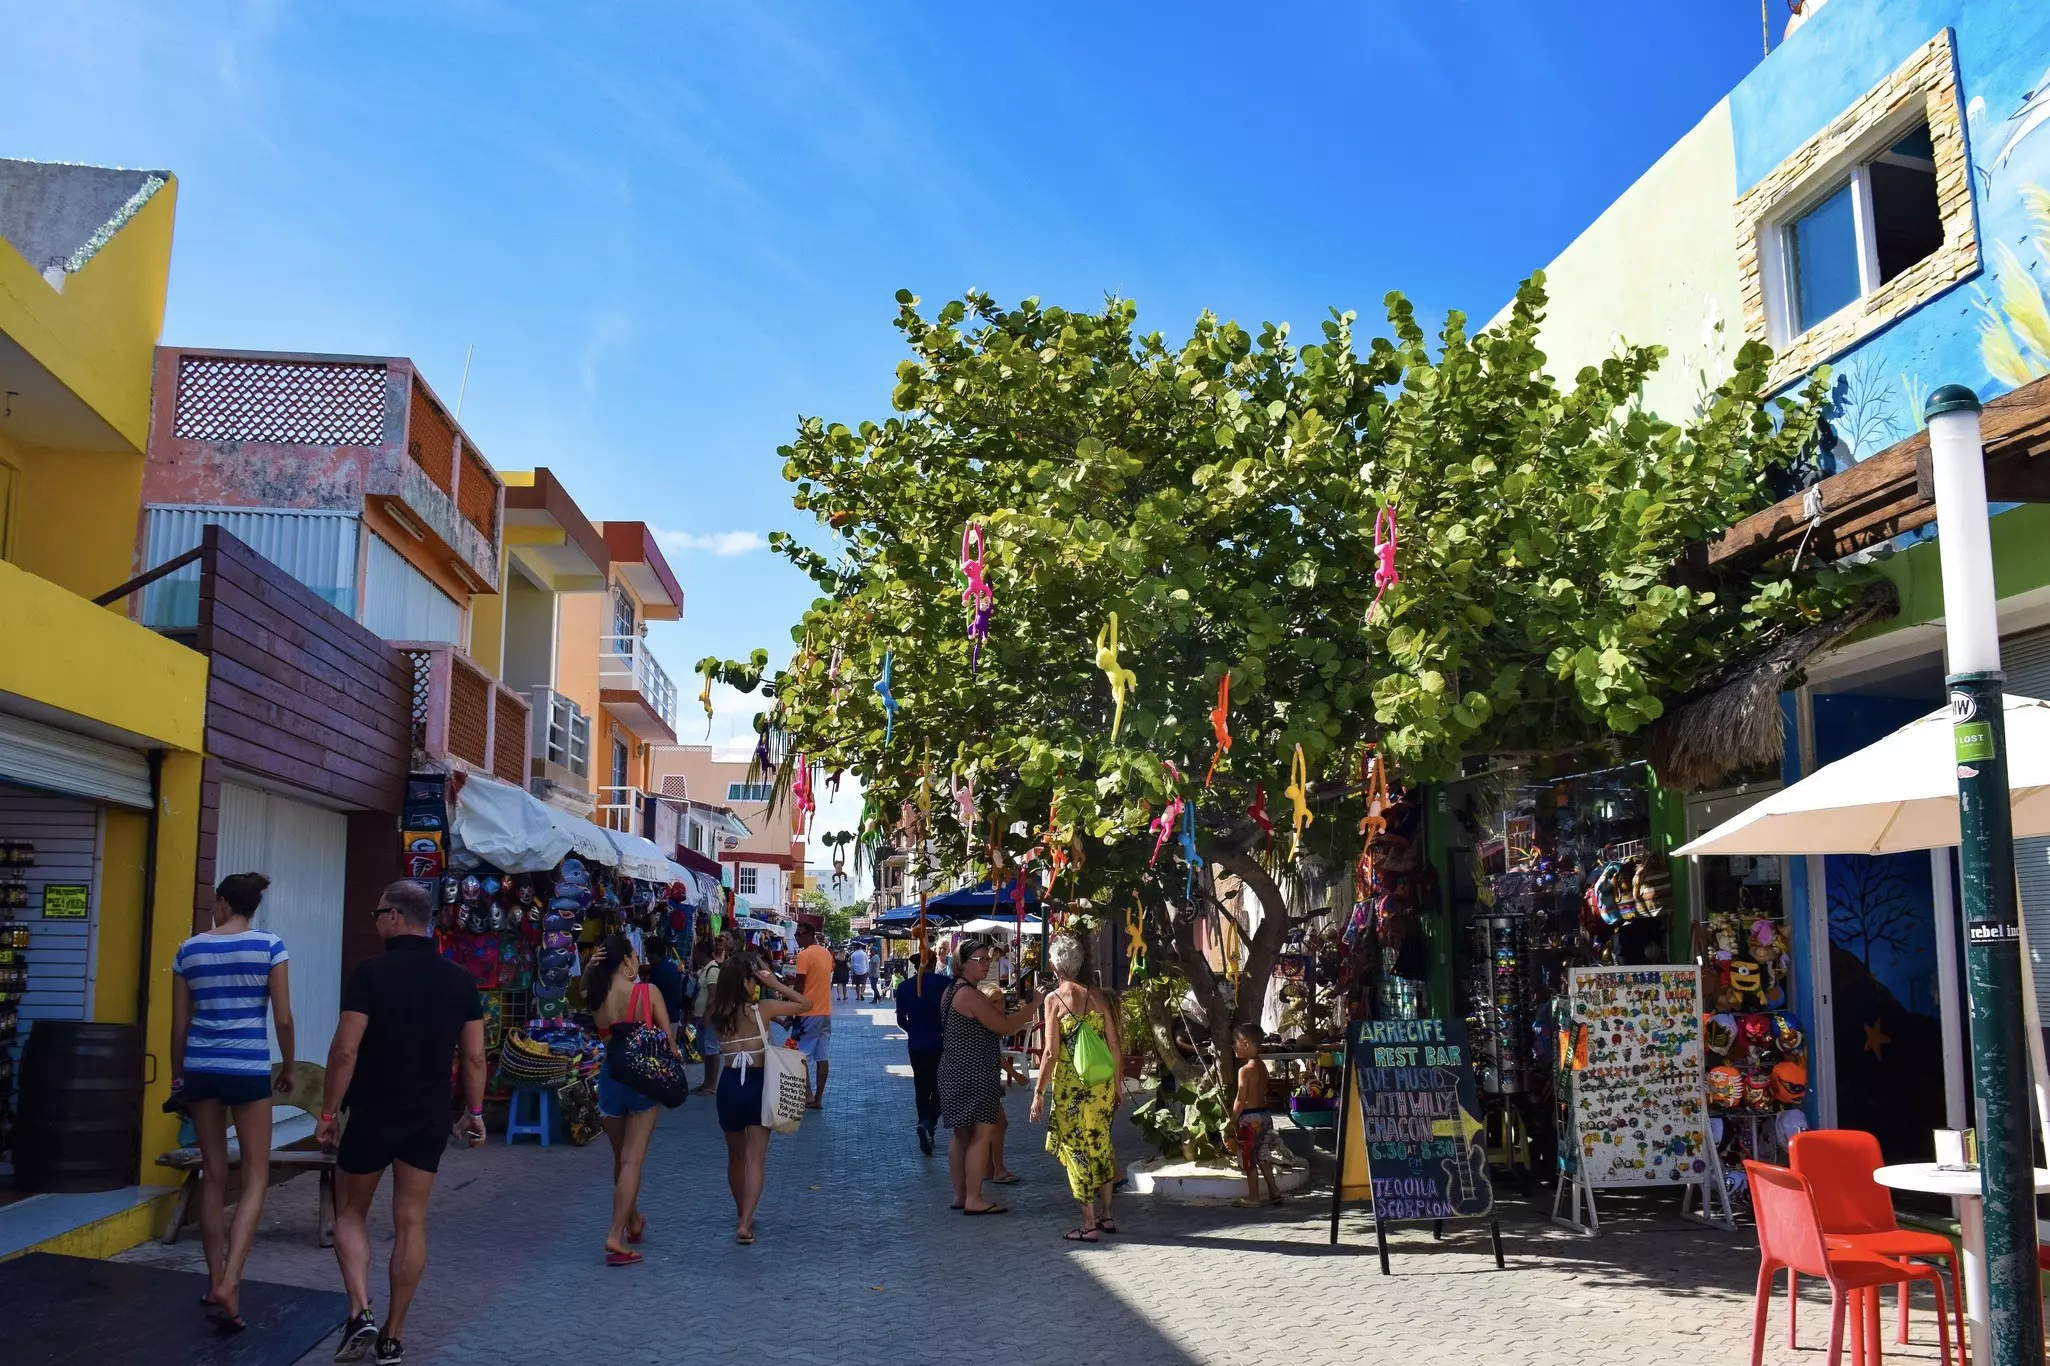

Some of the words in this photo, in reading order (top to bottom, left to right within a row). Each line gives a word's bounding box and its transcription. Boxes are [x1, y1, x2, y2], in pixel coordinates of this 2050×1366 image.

[1959, 734, 1984, 744] LOST
[1971, 924, 2004, 938] rebel
[1358, 1019, 1446, 1044] ARRECIFE
[1374, 1047, 1418, 1067] REST
[1425, 1045, 1462, 1066] BAR
[780, 1079, 802, 1089] London
[1358, 1067, 1391, 1092] LIVE
[780, 1085, 798, 1095] Berlin
[780, 1091, 797, 1100] Seoul
[779, 1103, 796, 1114] Tokyo
[780, 1097, 799, 1108] Mexico
[1361, 1091, 1408, 1116] WITH
[1408, 1091, 1454, 1116] WILLY
[778, 1109, 788, 1118] Los
[1365, 1117, 1434, 1142] CHACON
[1407, 1144, 1417, 1155] AT
[1372, 1177, 1439, 1198] TEQUILA
[1376, 1198, 1452, 1219] SCORPION
